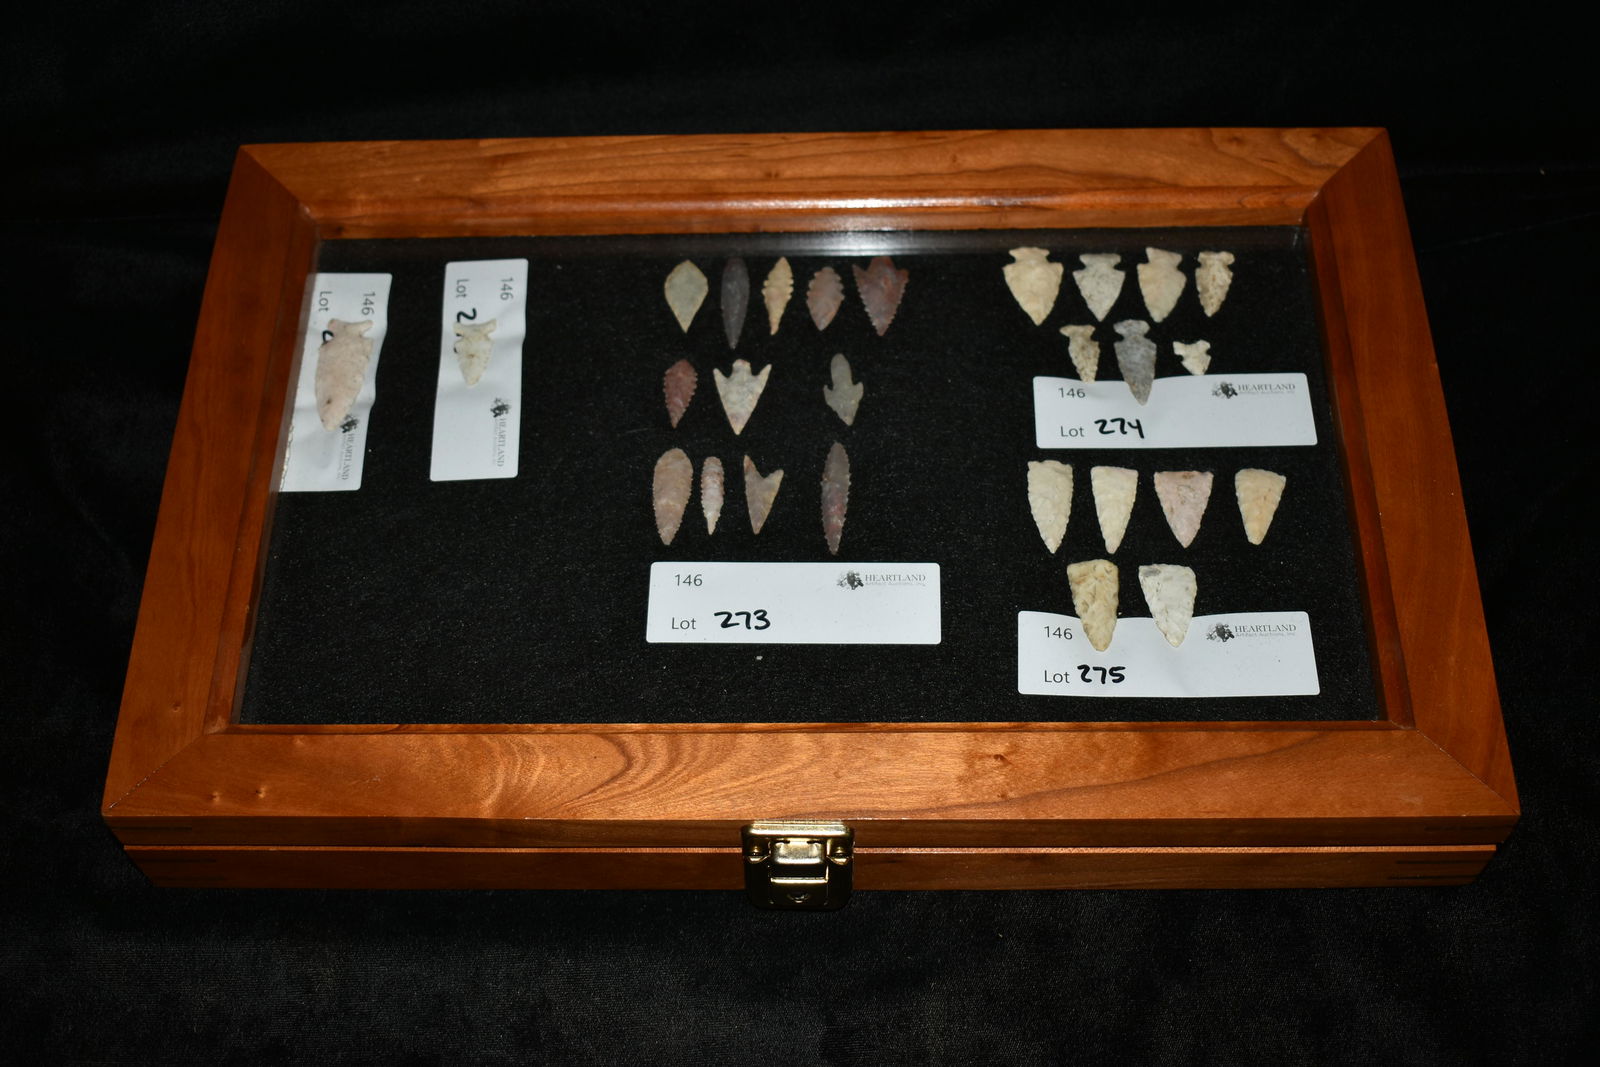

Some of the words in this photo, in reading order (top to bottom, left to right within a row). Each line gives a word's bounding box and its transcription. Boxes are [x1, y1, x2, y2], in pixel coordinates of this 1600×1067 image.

[456, 278, 470, 298] Lot
[500, 277, 514, 300] 146
[318, 290, 333, 312] Lot
[361, 291, 376, 316] 146
[1058, 387, 1086, 399] 146
[1238, 383, 1296, 391] HEARTLAND
[1060, 425, 1085, 438] Lot
[1094, 418, 1145, 439] 274
[674, 574, 703, 587] 146
[671, 617, 697, 630] Lot
[714, 609, 771, 630] 273
[1234, 624, 1297, 632] HEARTLAND
[1044, 626, 1073, 640] 146
[1044, 670, 1070, 684] Lot
[1077, 664, 1126, 684] 275
